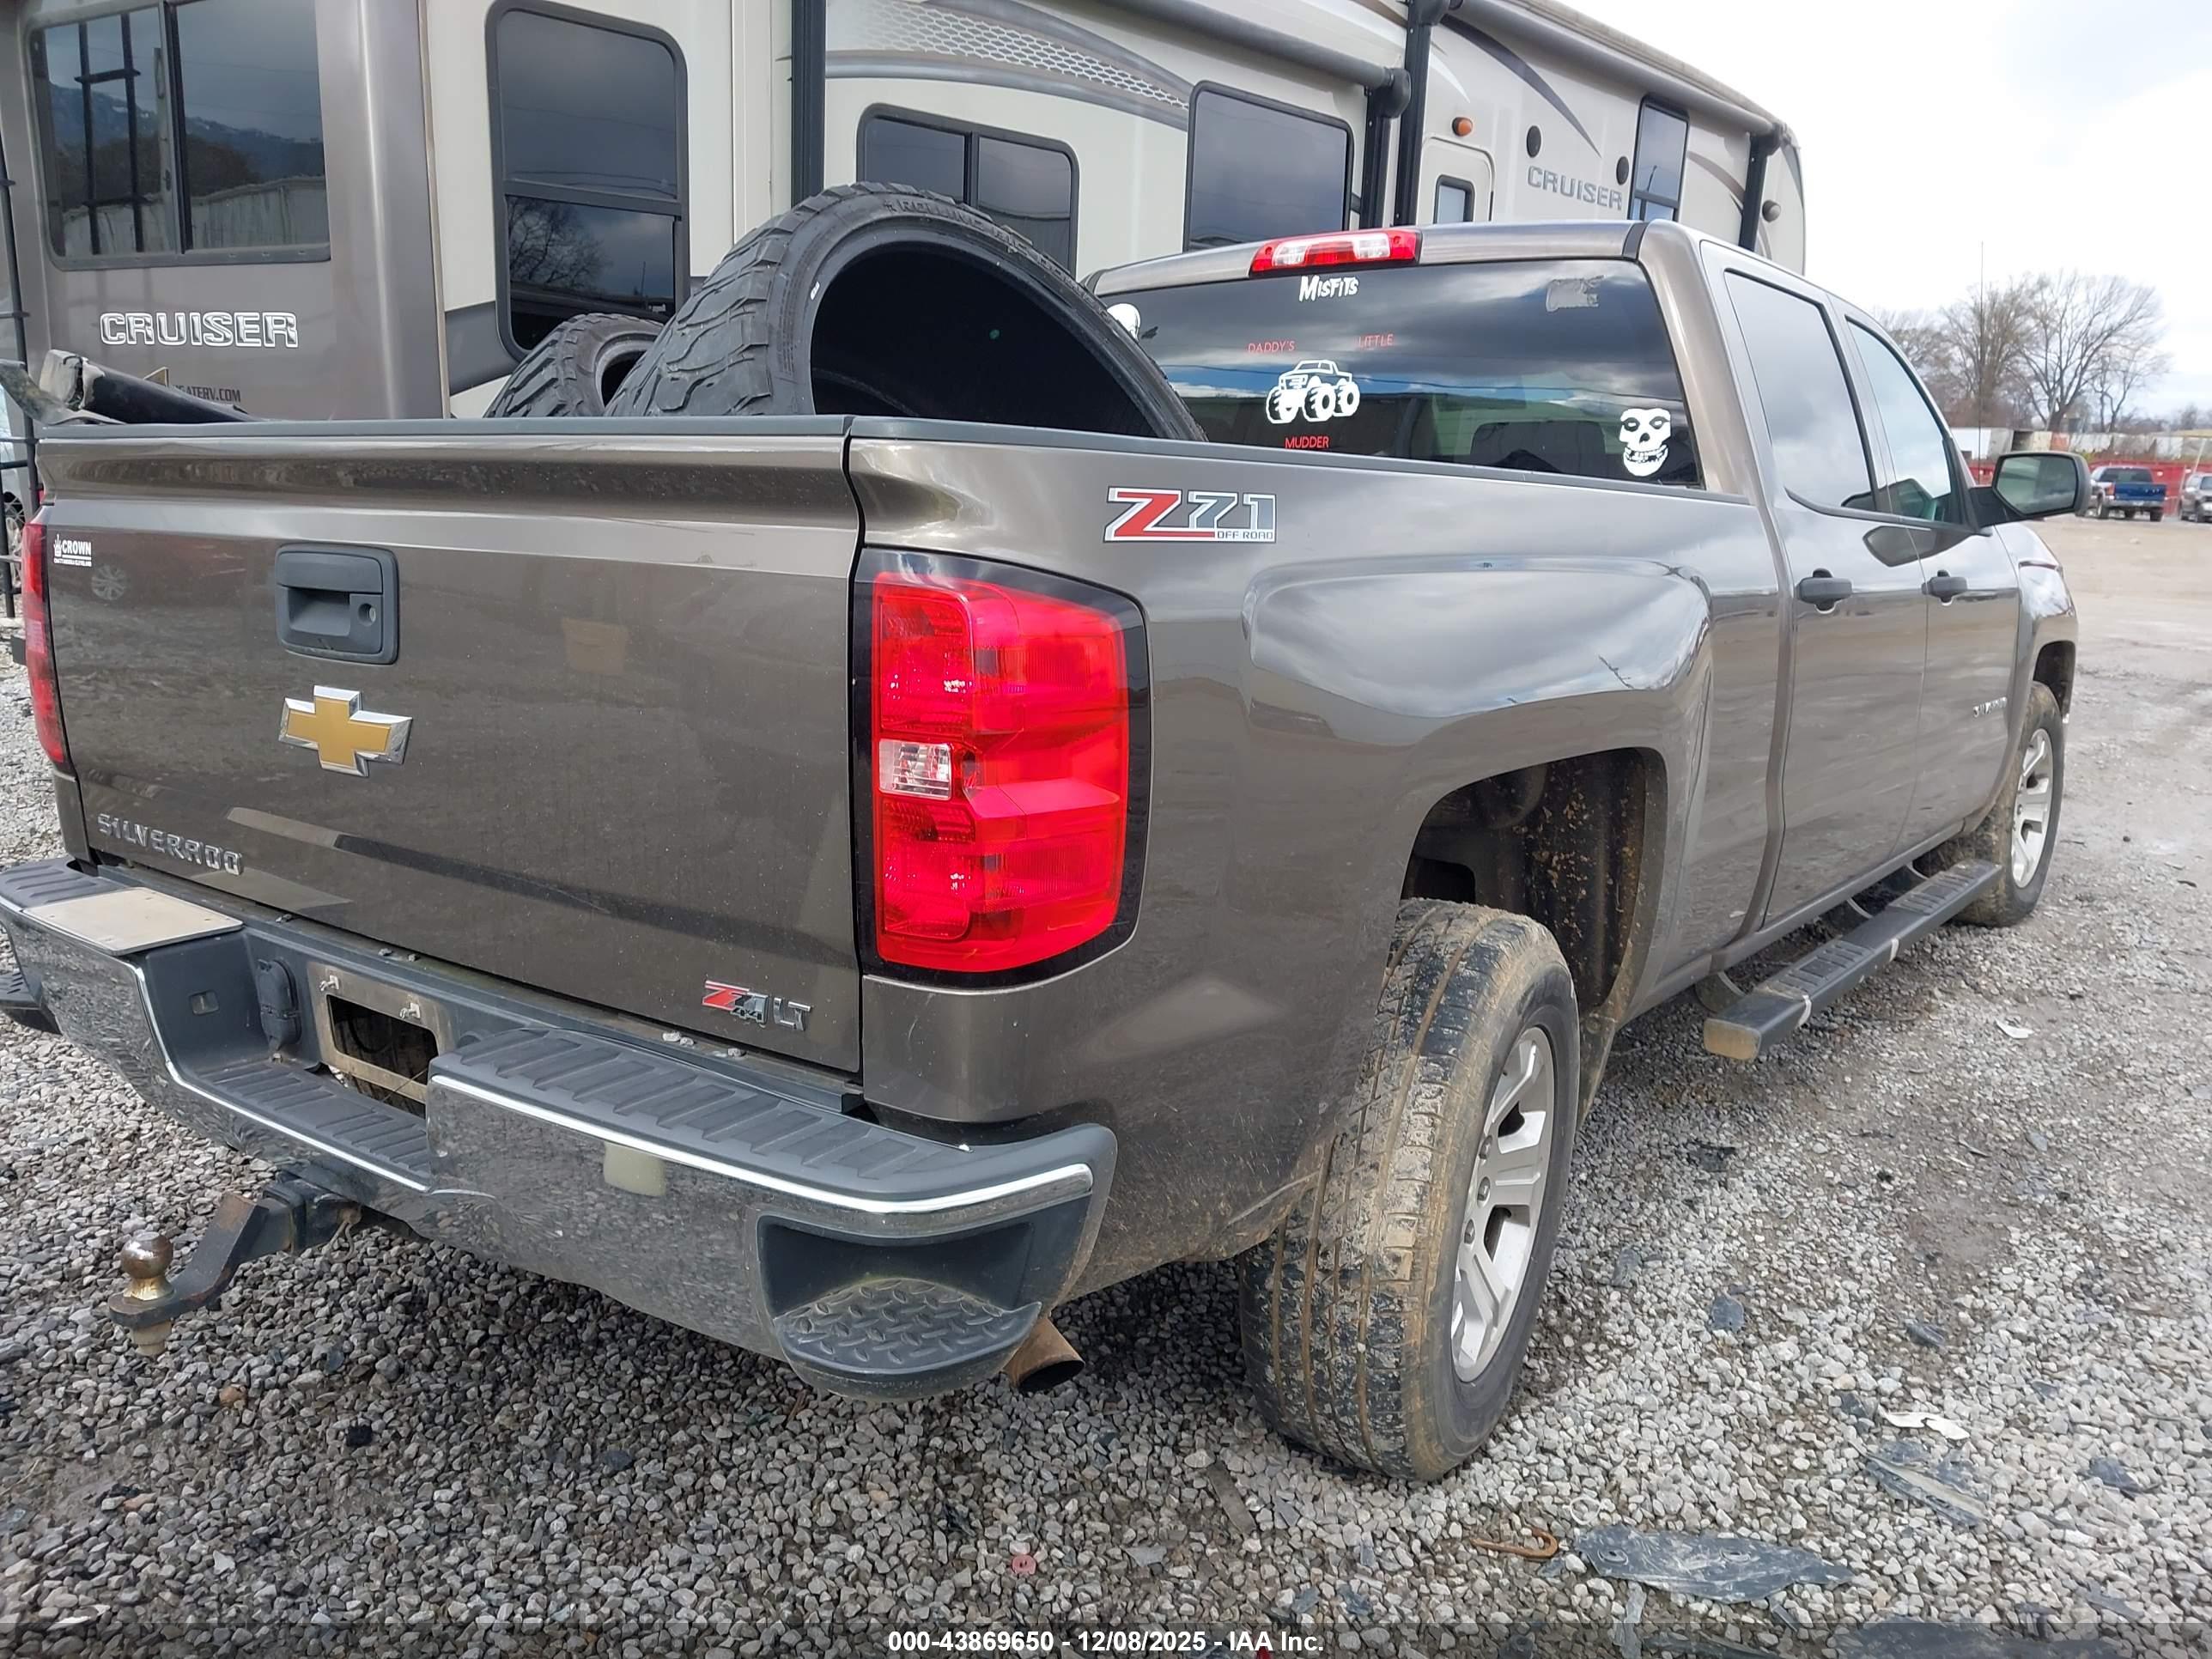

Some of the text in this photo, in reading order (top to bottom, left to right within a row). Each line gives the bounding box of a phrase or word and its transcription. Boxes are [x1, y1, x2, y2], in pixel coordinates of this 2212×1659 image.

[1528, 166, 1623, 210] CRUISER
[100, 311, 299, 348] CRUISER
[1248, 333, 1395, 354] DADDY'S LITTLE
[1285, 435, 1330, 450] MUDDER
[1103, 486, 1276, 543] Z71
[62, 539, 92, 556] CROWN
[1217, 530, 1273, 539] OFF ROAD
[97, 813, 244, 876] SILVERADO
[773, 997, 812, 1031] LT
